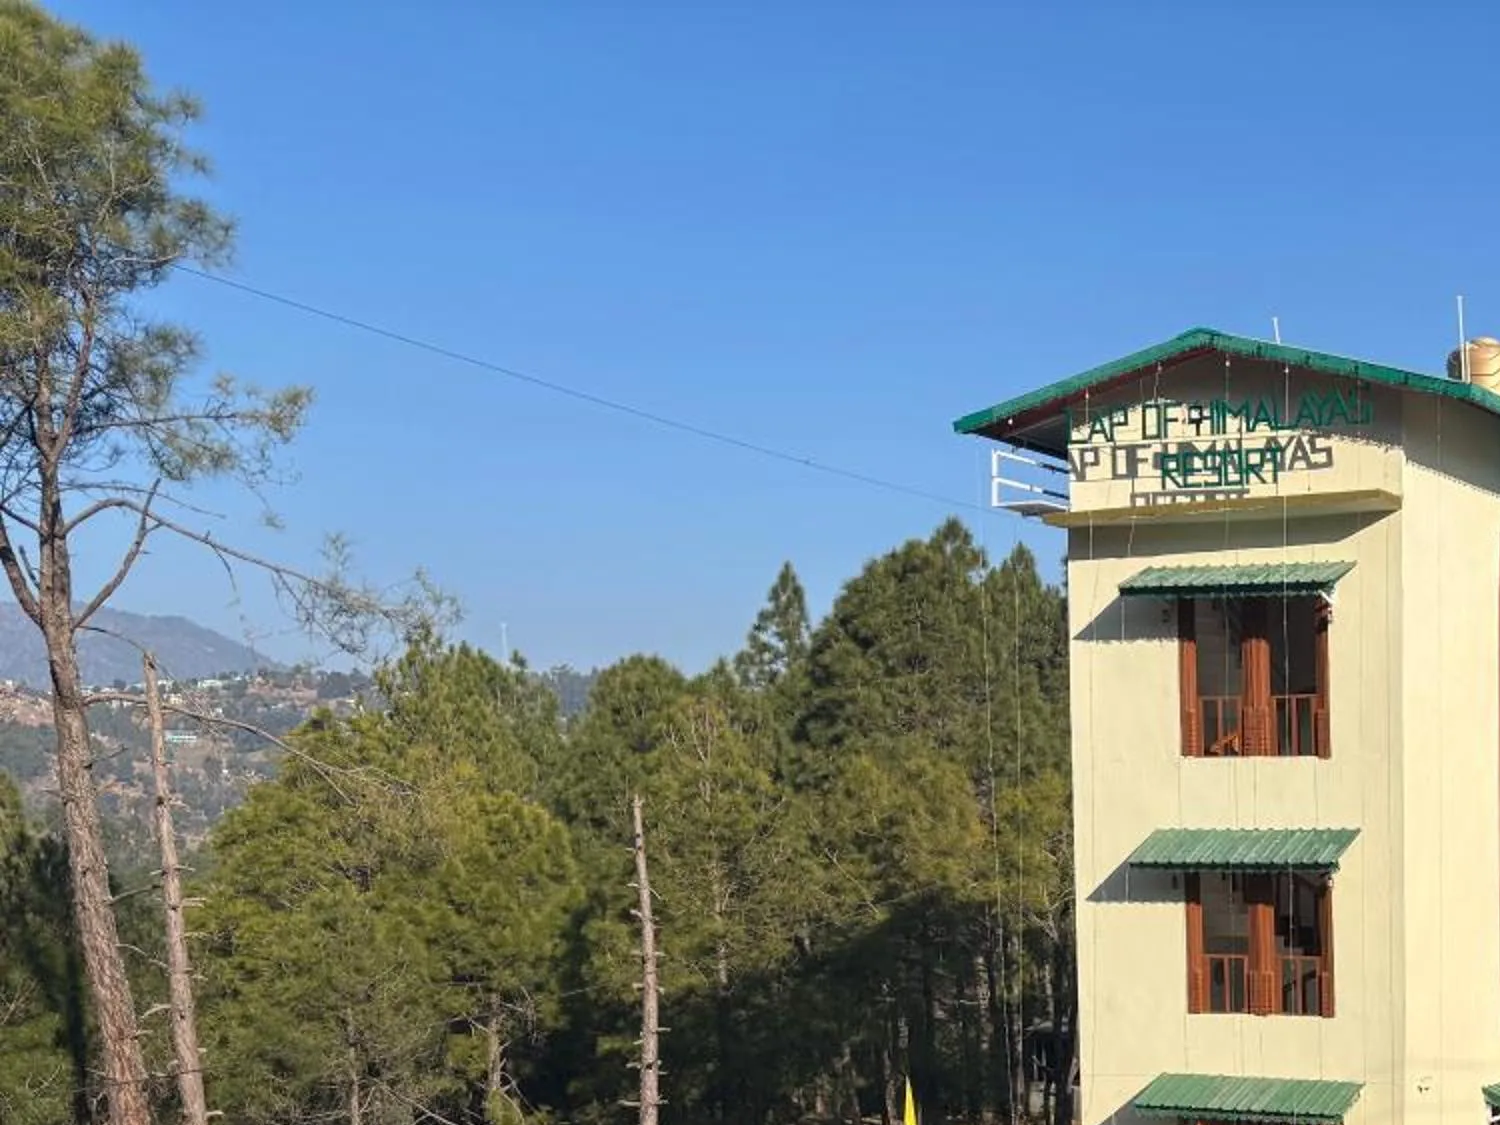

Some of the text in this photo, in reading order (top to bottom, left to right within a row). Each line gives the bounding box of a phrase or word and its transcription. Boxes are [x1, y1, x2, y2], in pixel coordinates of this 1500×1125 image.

[1067, 382, 1373, 446] LAP OF HIMALAYAS
[1160, 445, 1281, 491] RESORT
